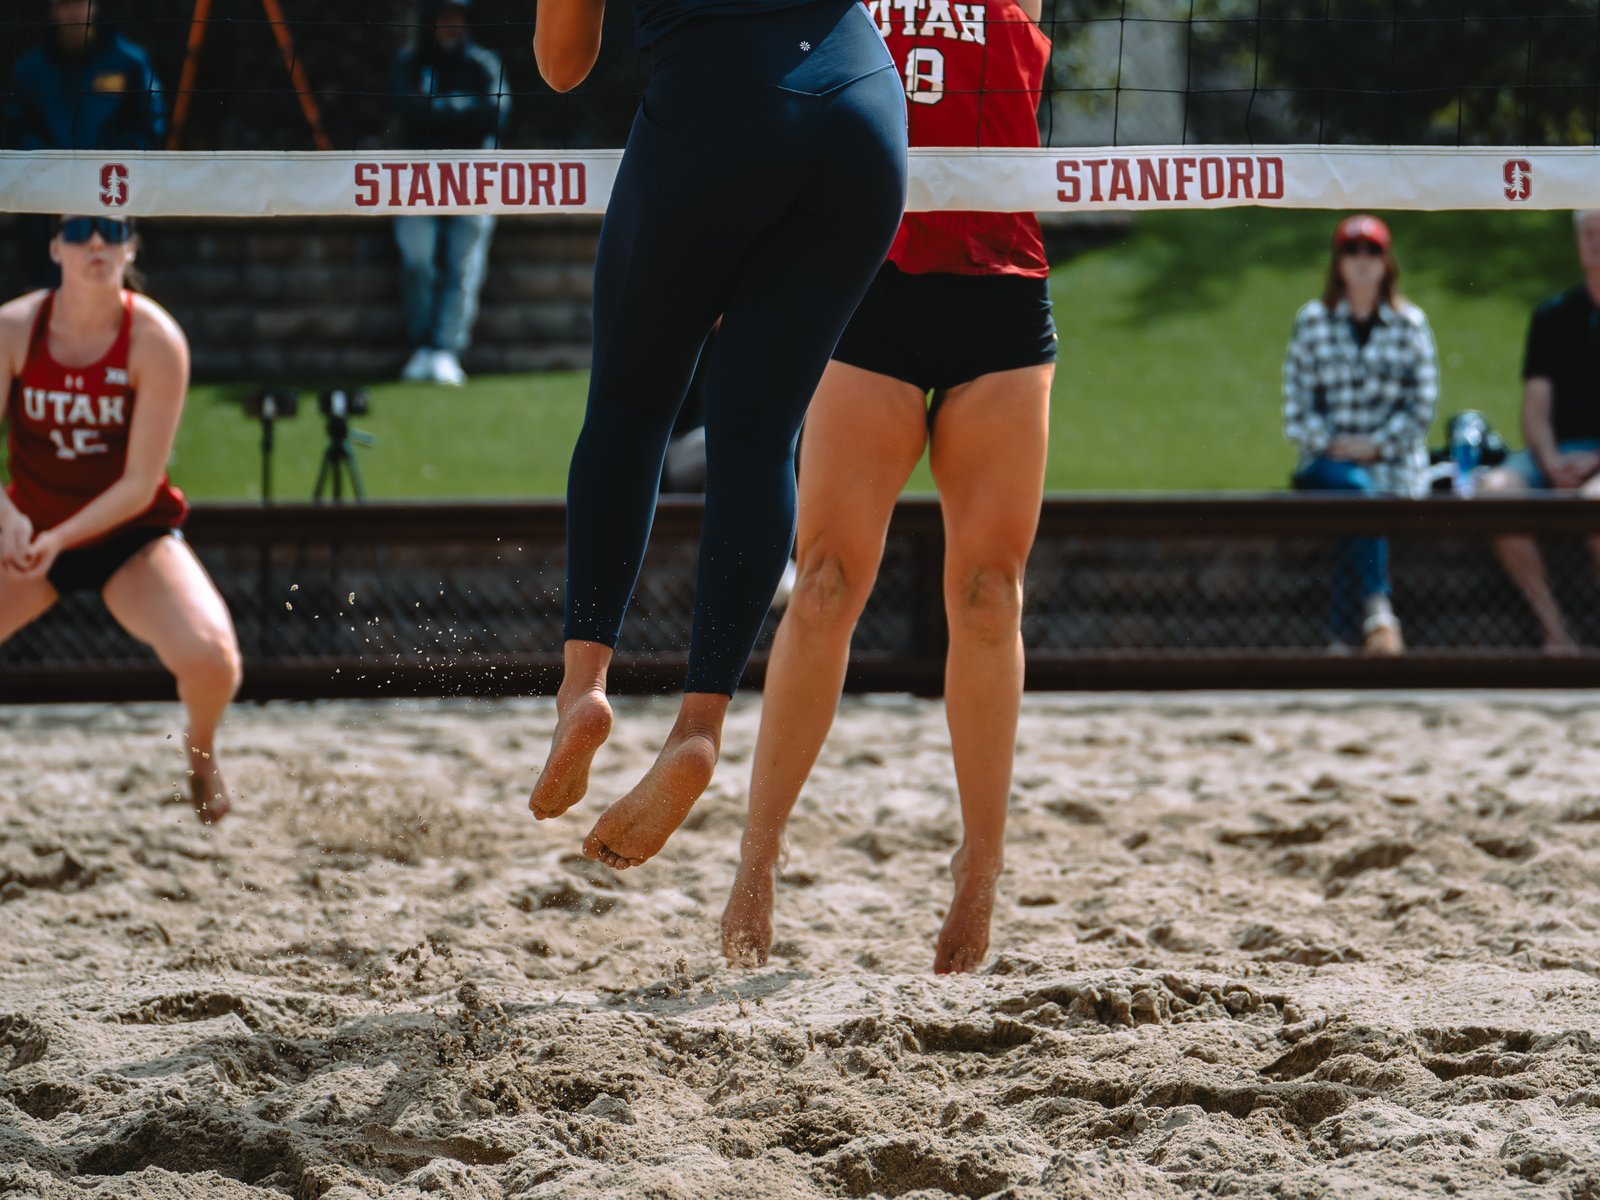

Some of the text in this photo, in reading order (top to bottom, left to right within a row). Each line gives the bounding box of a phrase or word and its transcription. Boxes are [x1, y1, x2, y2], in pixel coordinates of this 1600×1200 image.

[905, 47, 945, 104] 8
[354, 162, 587, 207] STANFORD
[1056, 157, 1285, 203] STANFORD
[23, 387, 125, 424] UTAH
